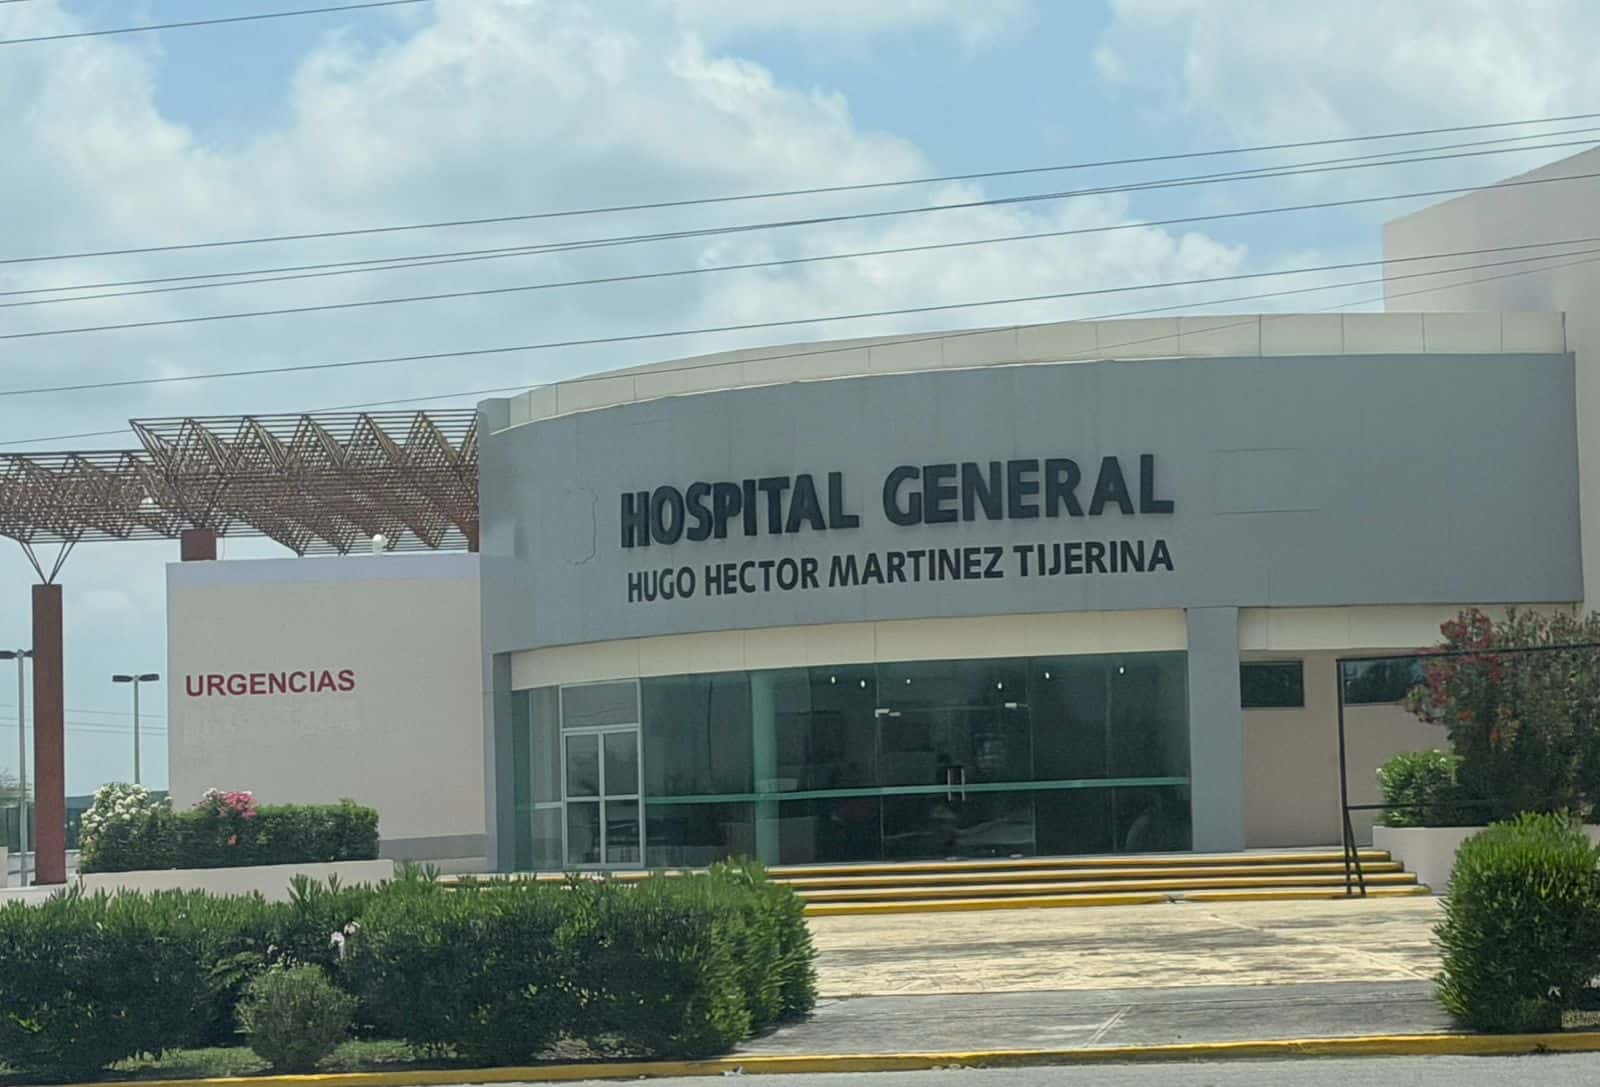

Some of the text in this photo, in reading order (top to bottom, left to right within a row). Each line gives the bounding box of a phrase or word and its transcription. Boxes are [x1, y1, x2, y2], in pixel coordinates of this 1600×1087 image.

[621, 453, 1175, 549] HOSPITAL GENERAL
[627, 539, 1175, 603] HUGO HECTOR MARTINEZ TIJERINA
[185, 670, 356, 697] URGENCIAS
